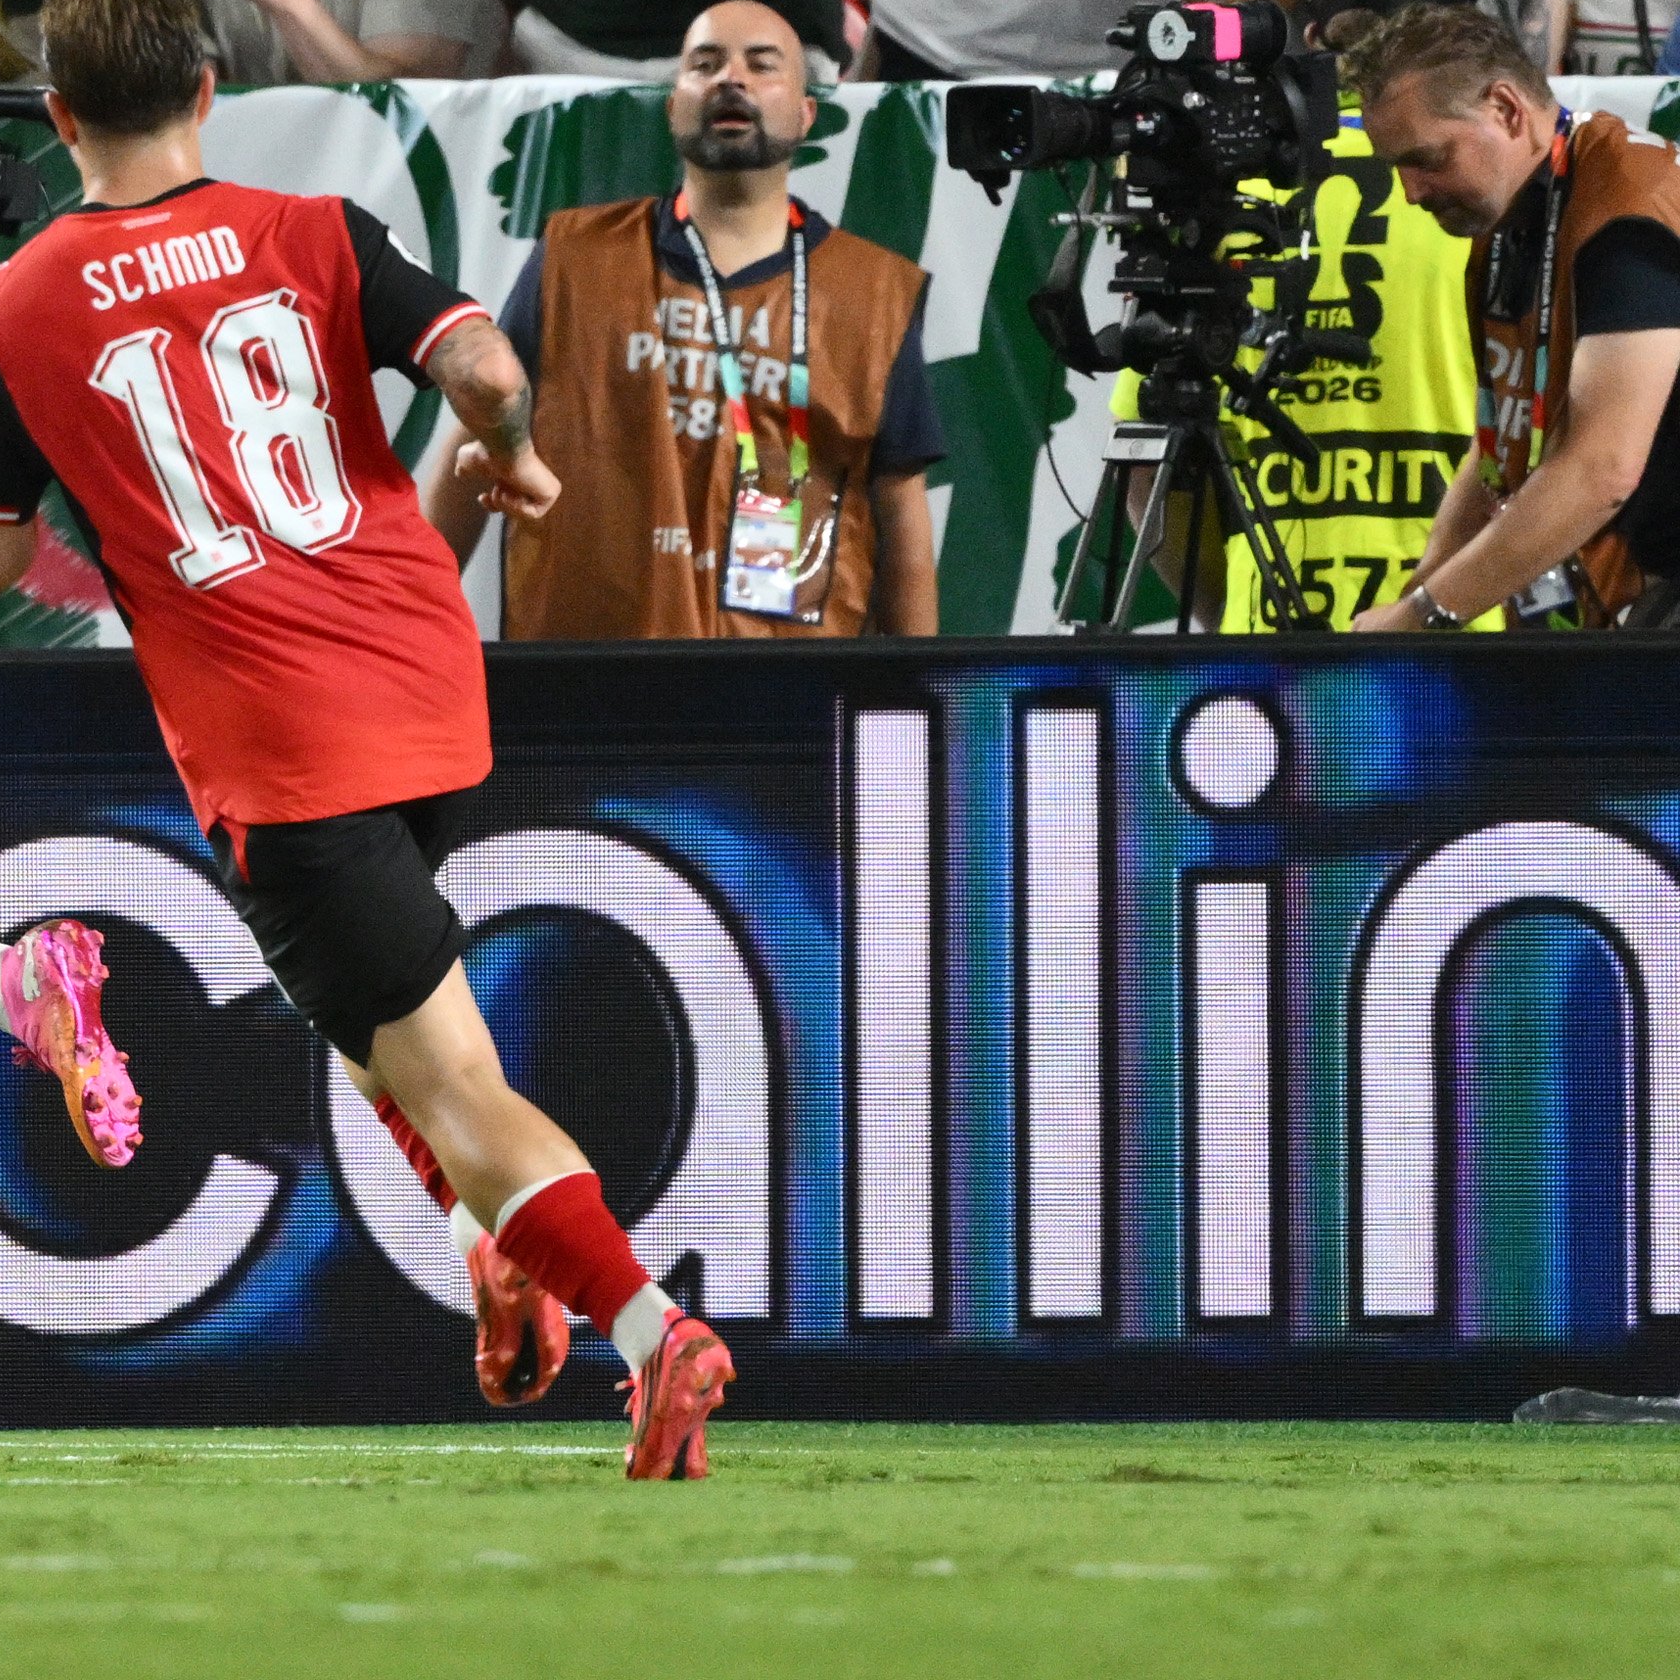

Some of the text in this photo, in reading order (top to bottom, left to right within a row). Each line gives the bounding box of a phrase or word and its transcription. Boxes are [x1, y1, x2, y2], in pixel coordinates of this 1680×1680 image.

[82, 225, 246, 311] SCHMID
[1304, 305, 1354, 330] FIFA
[88, 287, 363, 591] 18
